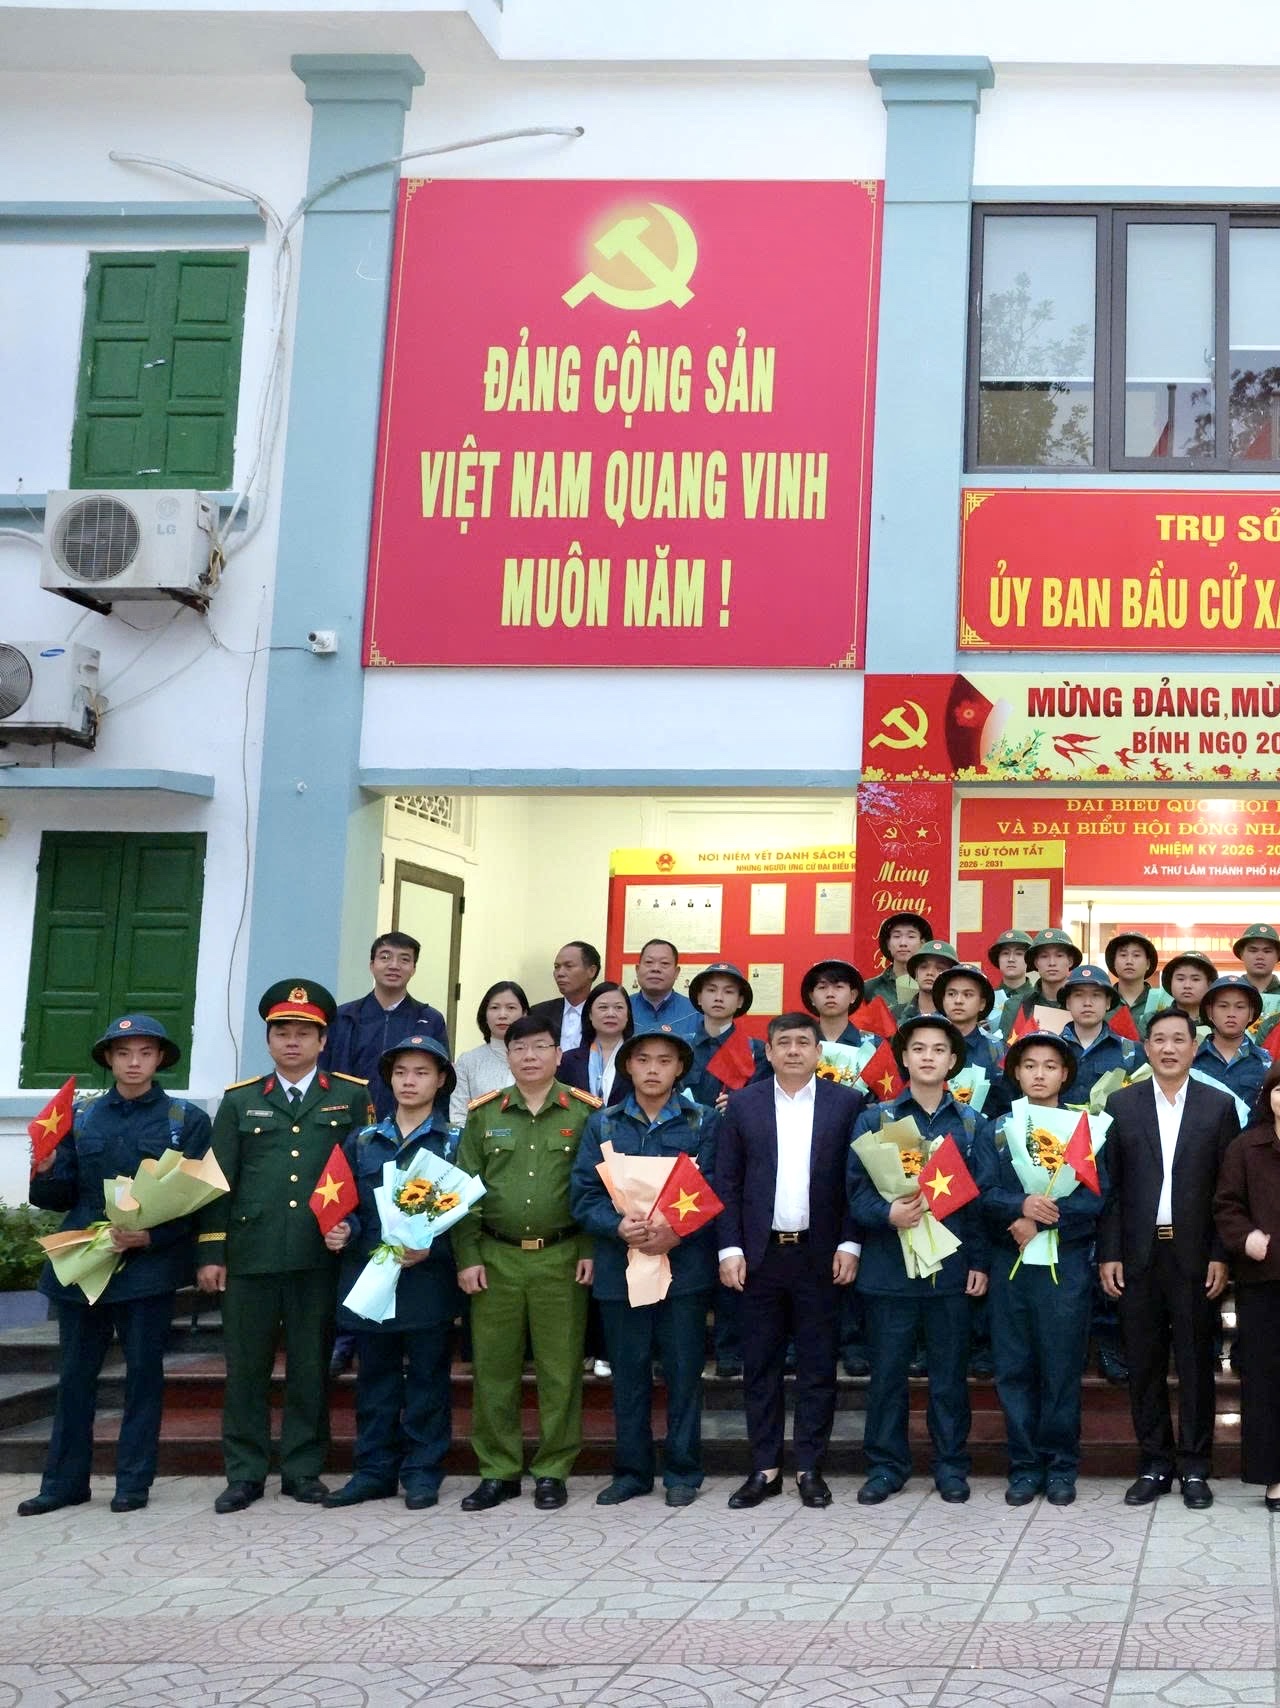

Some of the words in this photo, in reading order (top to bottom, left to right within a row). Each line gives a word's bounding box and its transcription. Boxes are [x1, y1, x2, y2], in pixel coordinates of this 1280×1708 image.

[483, 327, 581, 412] ĐẢNG
[595, 330, 692, 428] CỘNG
[705, 327, 776, 413] SẢN
[420, 434, 500, 534] VIỆT
[511, 452, 592, 518] NAM
[605, 450, 727, 528] QUANG
[742, 452, 828, 520] VINH
[1156, 514, 1225, 547] TRỤ
[501, 541, 611, 627] MUÔN
[624, 544, 705, 627] NĂM
[989, 559, 1032, 628] ỦY
[1042, 577, 1110, 628] BAN
[1122, 560, 1188, 629] BẦU
[1200, 561, 1247, 629] CỬ
[1027, 681, 1122, 718] MỪNG
[1132, 726, 1190, 754] BÍNH
[1199, 732, 1248, 760] NGỌ
[997, 816, 1025, 834] VÀ
[1032, 822, 1070, 838] ĐẠI
[1076, 815, 1127, 835] BIỂU
[1133, 820, 1170, 838] HỘI
[1179, 816, 1238, 835] ĐỒNG
[776, 852, 809, 860] DANH
[993, 846, 1018, 856] TÓM
[1023, 844, 1044, 855] TẮT
[1150, 844, 1193, 858] NHIỆM
[1222, 845, 1254, 856] 2026
[873, 860, 929, 887] Mừng
